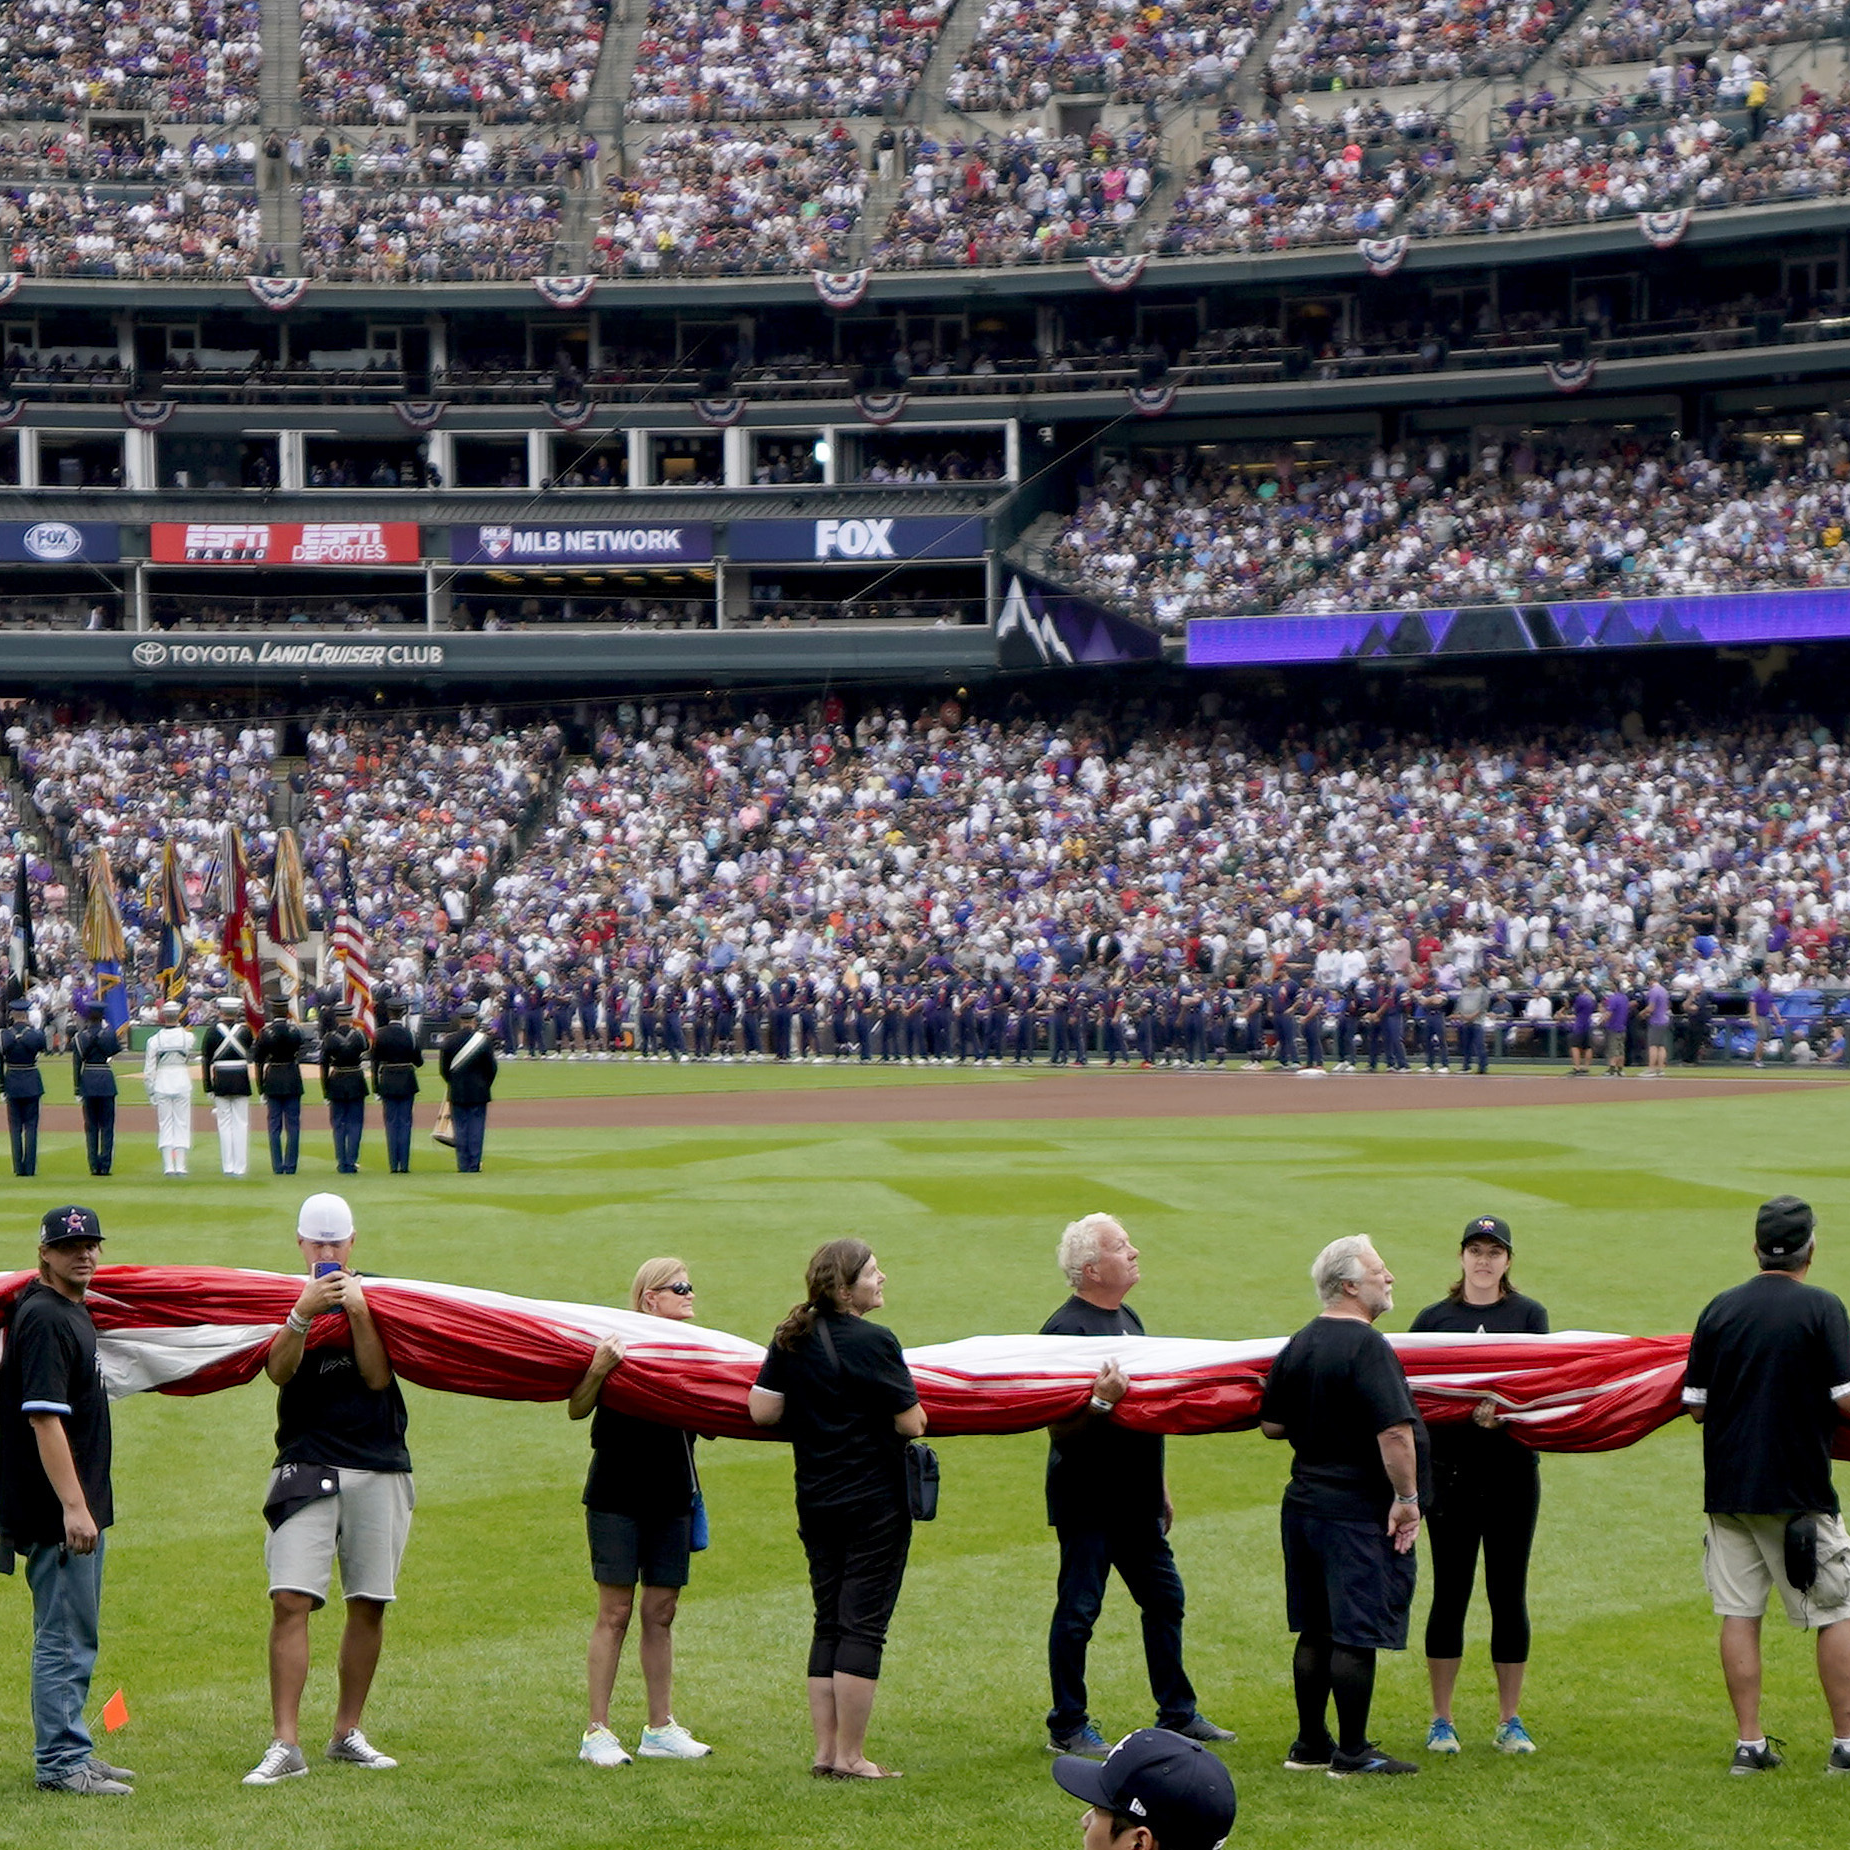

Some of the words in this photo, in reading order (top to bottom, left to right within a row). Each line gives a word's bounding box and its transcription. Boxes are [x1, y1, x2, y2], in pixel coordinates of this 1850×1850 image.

[37, 528, 68, 544] FOX
[184, 524, 271, 548] ESPN
[301, 523, 383, 545] ESPN
[512, 530, 561, 553] MLB
[563, 528, 683, 553] NETWORK
[814, 518, 896, 557] FOX
[185, 548, 267, 560] RADIO
[291, 545, 388, 560] DEPORTES
[168, 644, 254, 663] TOYOTA
[386, 645, 444, 664] CLUB
